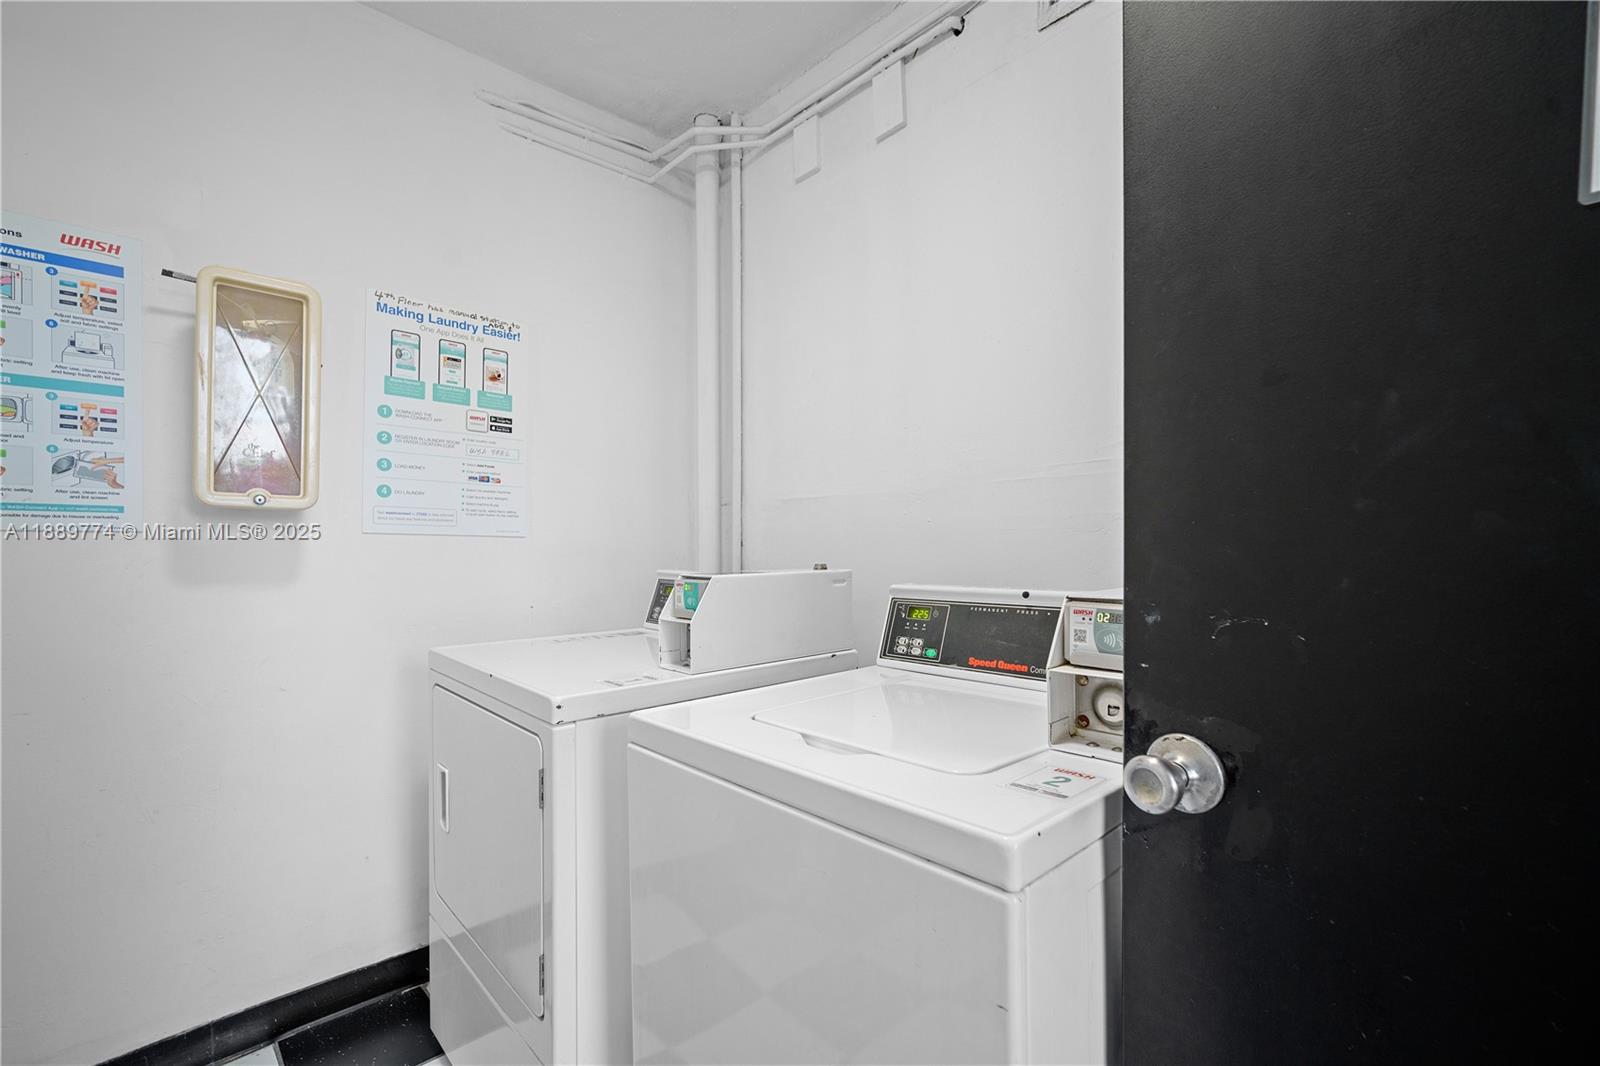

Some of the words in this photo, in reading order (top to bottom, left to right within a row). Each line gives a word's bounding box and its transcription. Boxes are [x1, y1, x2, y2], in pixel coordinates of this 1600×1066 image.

[60, 233, 121, 255] WASH
[397, 296, 424, 306] Floor
[376, 301, 424, 324] Making
[428, 313, 479, 335] Laundry
[482, 325, 521, 342] Easier!
[419, 324, 435, 333] One
[436, 328, 449, 337] App
[451, 331, 469, 340] Does
[911, 609, 930, 619] 225
[1073, 608, 1094, 616] WASH
[968, 656, 997, 668] Speed
[997, 660, 1028, 673] Queen
[1054, 767, 1096, 780] WASH
[1042, 776, 1072, 788] 2
